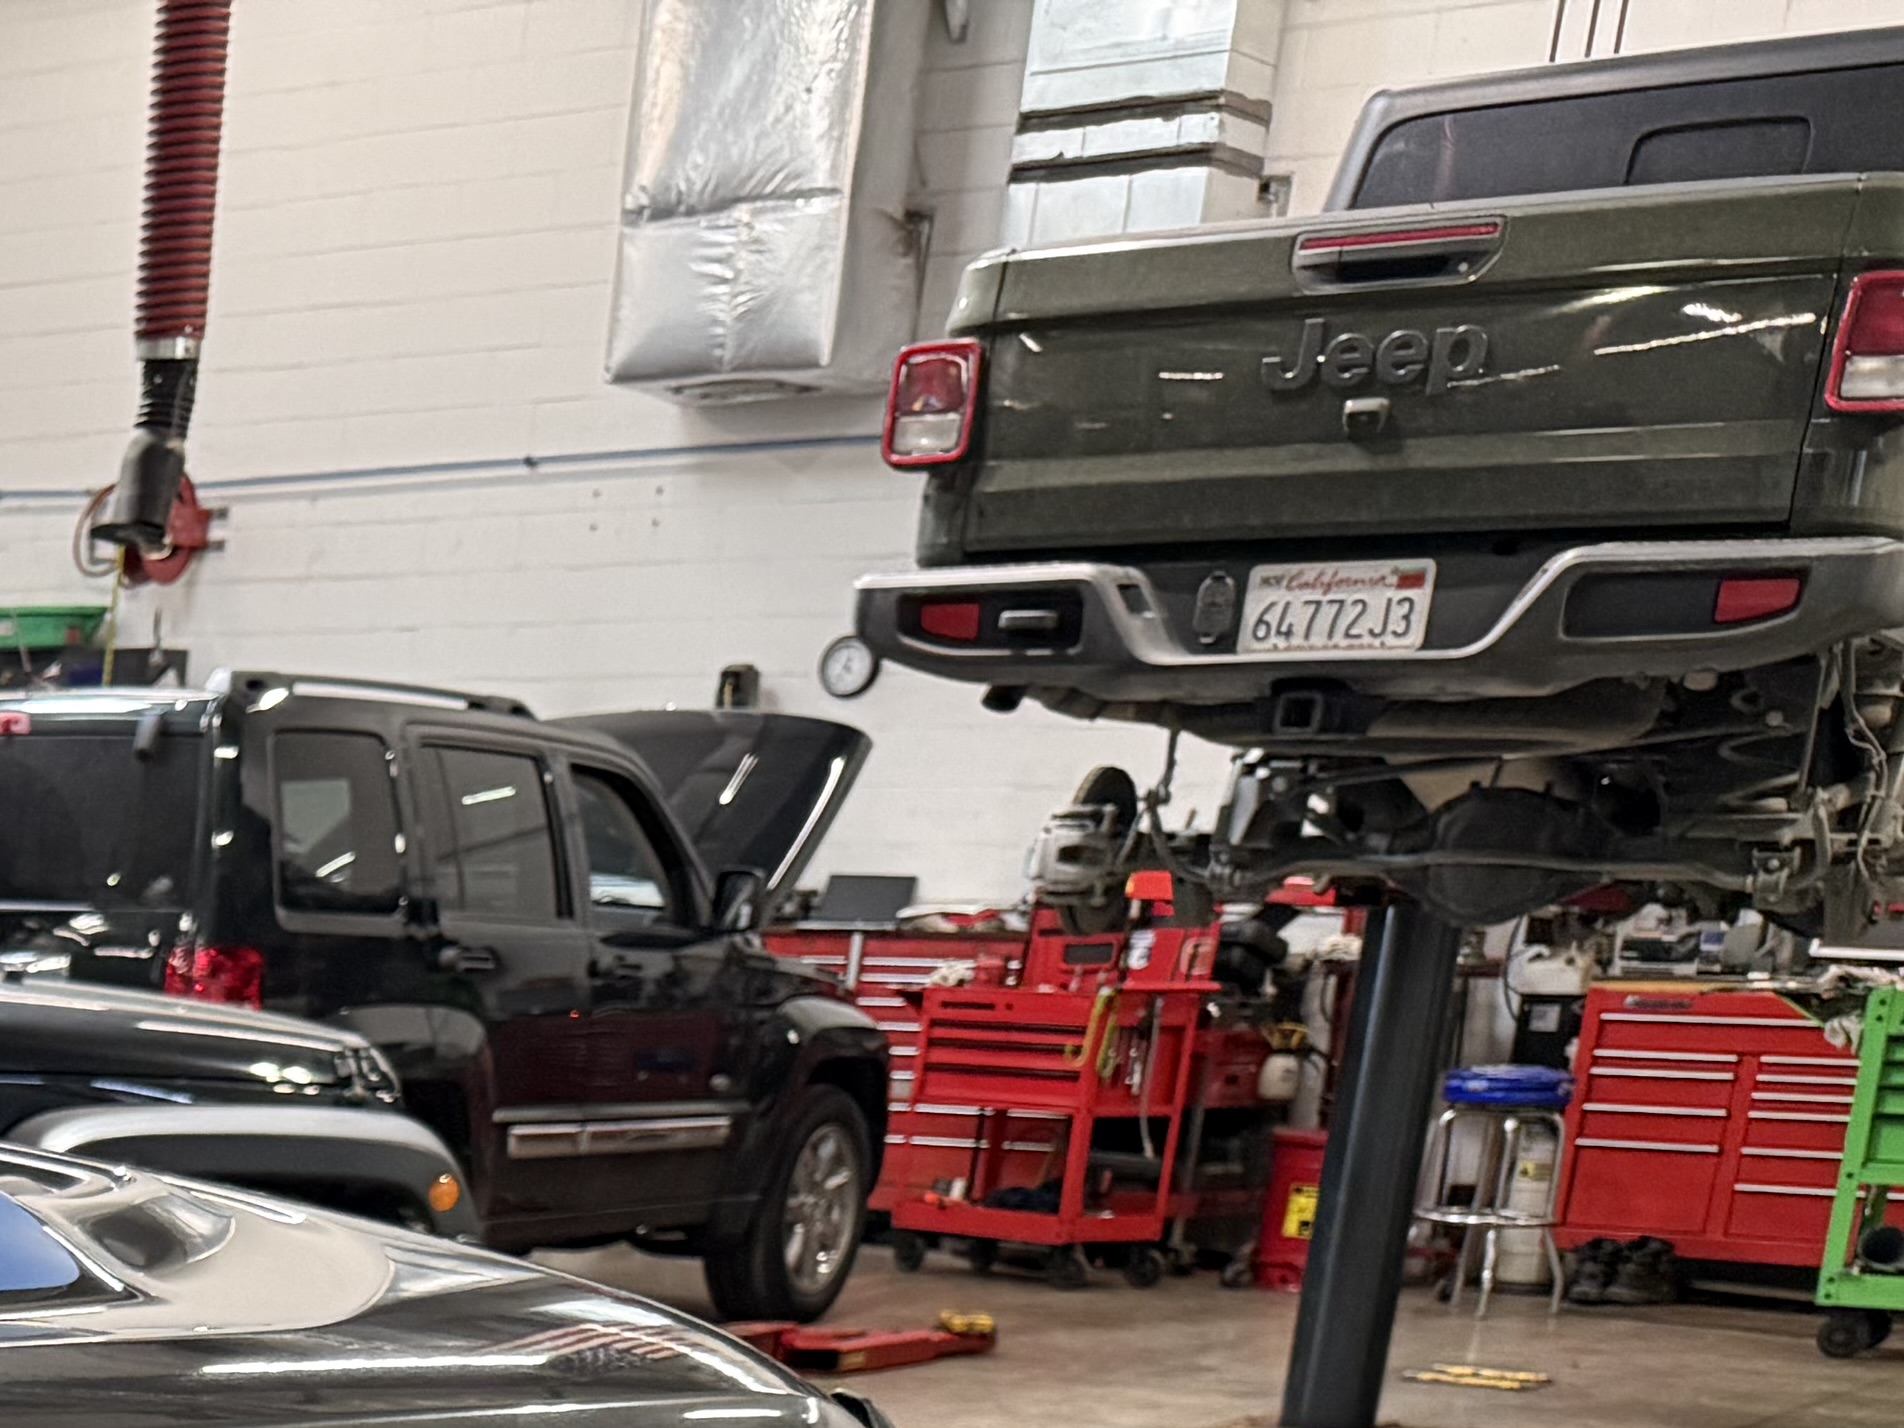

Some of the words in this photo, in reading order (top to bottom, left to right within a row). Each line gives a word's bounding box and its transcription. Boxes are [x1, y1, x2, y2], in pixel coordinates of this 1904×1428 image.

[1260, 317, 1488, 396] Jeep
[1285, 566, 1399, 597] California
[1252, 597, 1415, 642] 64772J3
